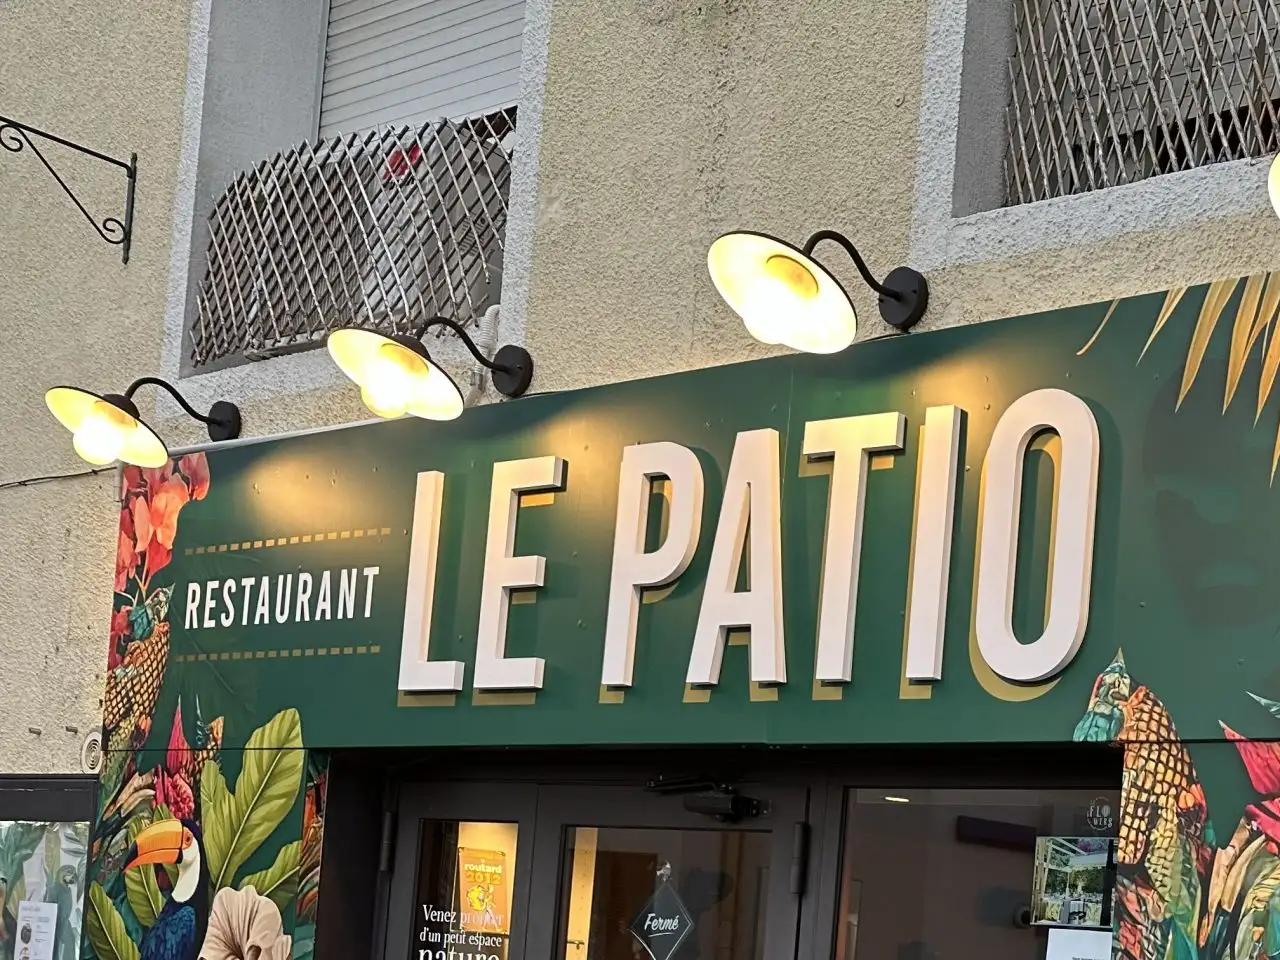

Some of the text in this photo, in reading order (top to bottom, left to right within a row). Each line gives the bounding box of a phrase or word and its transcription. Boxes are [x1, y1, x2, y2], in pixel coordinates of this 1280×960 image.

[398, 388, 1100, 691] LE PATIO
[184, 566, 379, 629] RESTAURANT
[466, 871, 501, 885] 2012
[422, 903, 457, 923] Venez
[644, 913, 679, 931] Fermé
[419, 926, 502, 951] d'un petit espace
